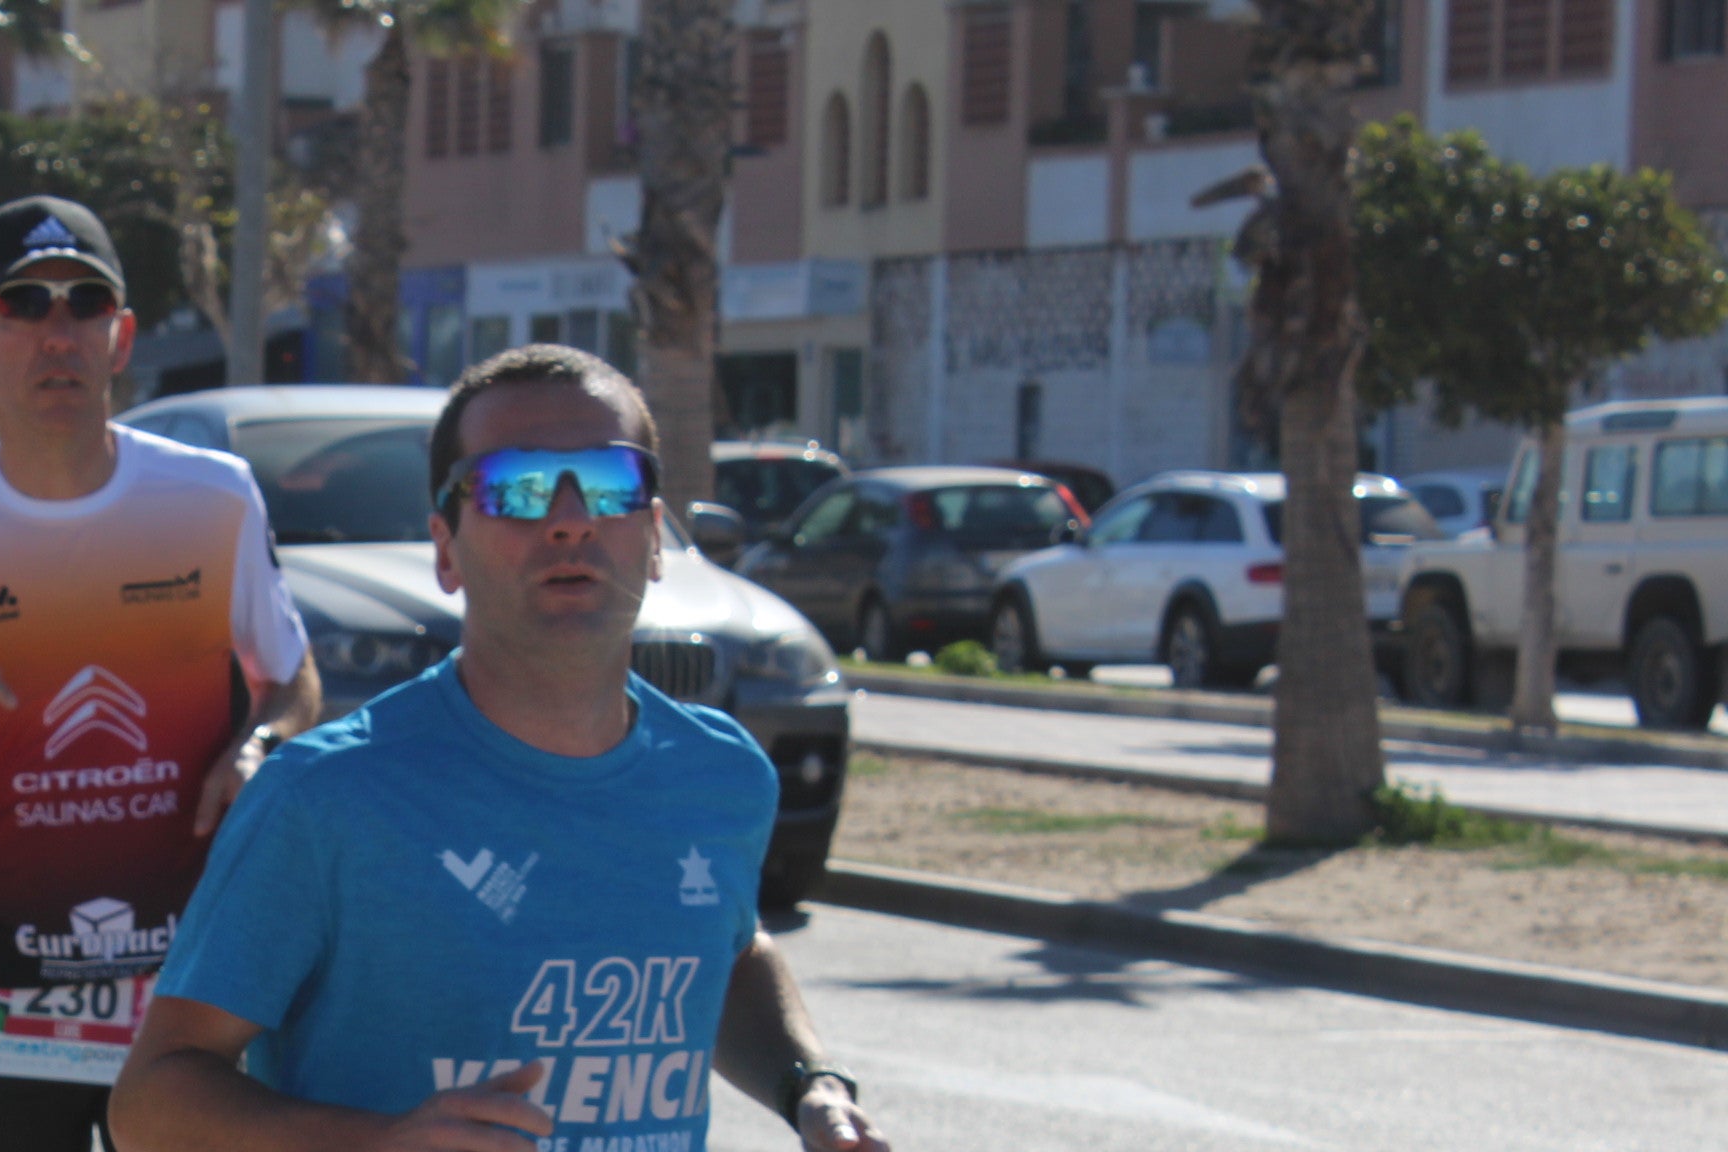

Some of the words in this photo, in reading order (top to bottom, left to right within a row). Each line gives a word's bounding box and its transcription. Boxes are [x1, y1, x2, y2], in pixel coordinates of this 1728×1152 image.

[14, 796, 126, 828] SALINAS
[129, 790, 179, 820] CAR
[27, 979, 117, 1020] 230
[511, 956, 701, 1048] 42K
[432, 1050, 709, 1124] VLENCI
